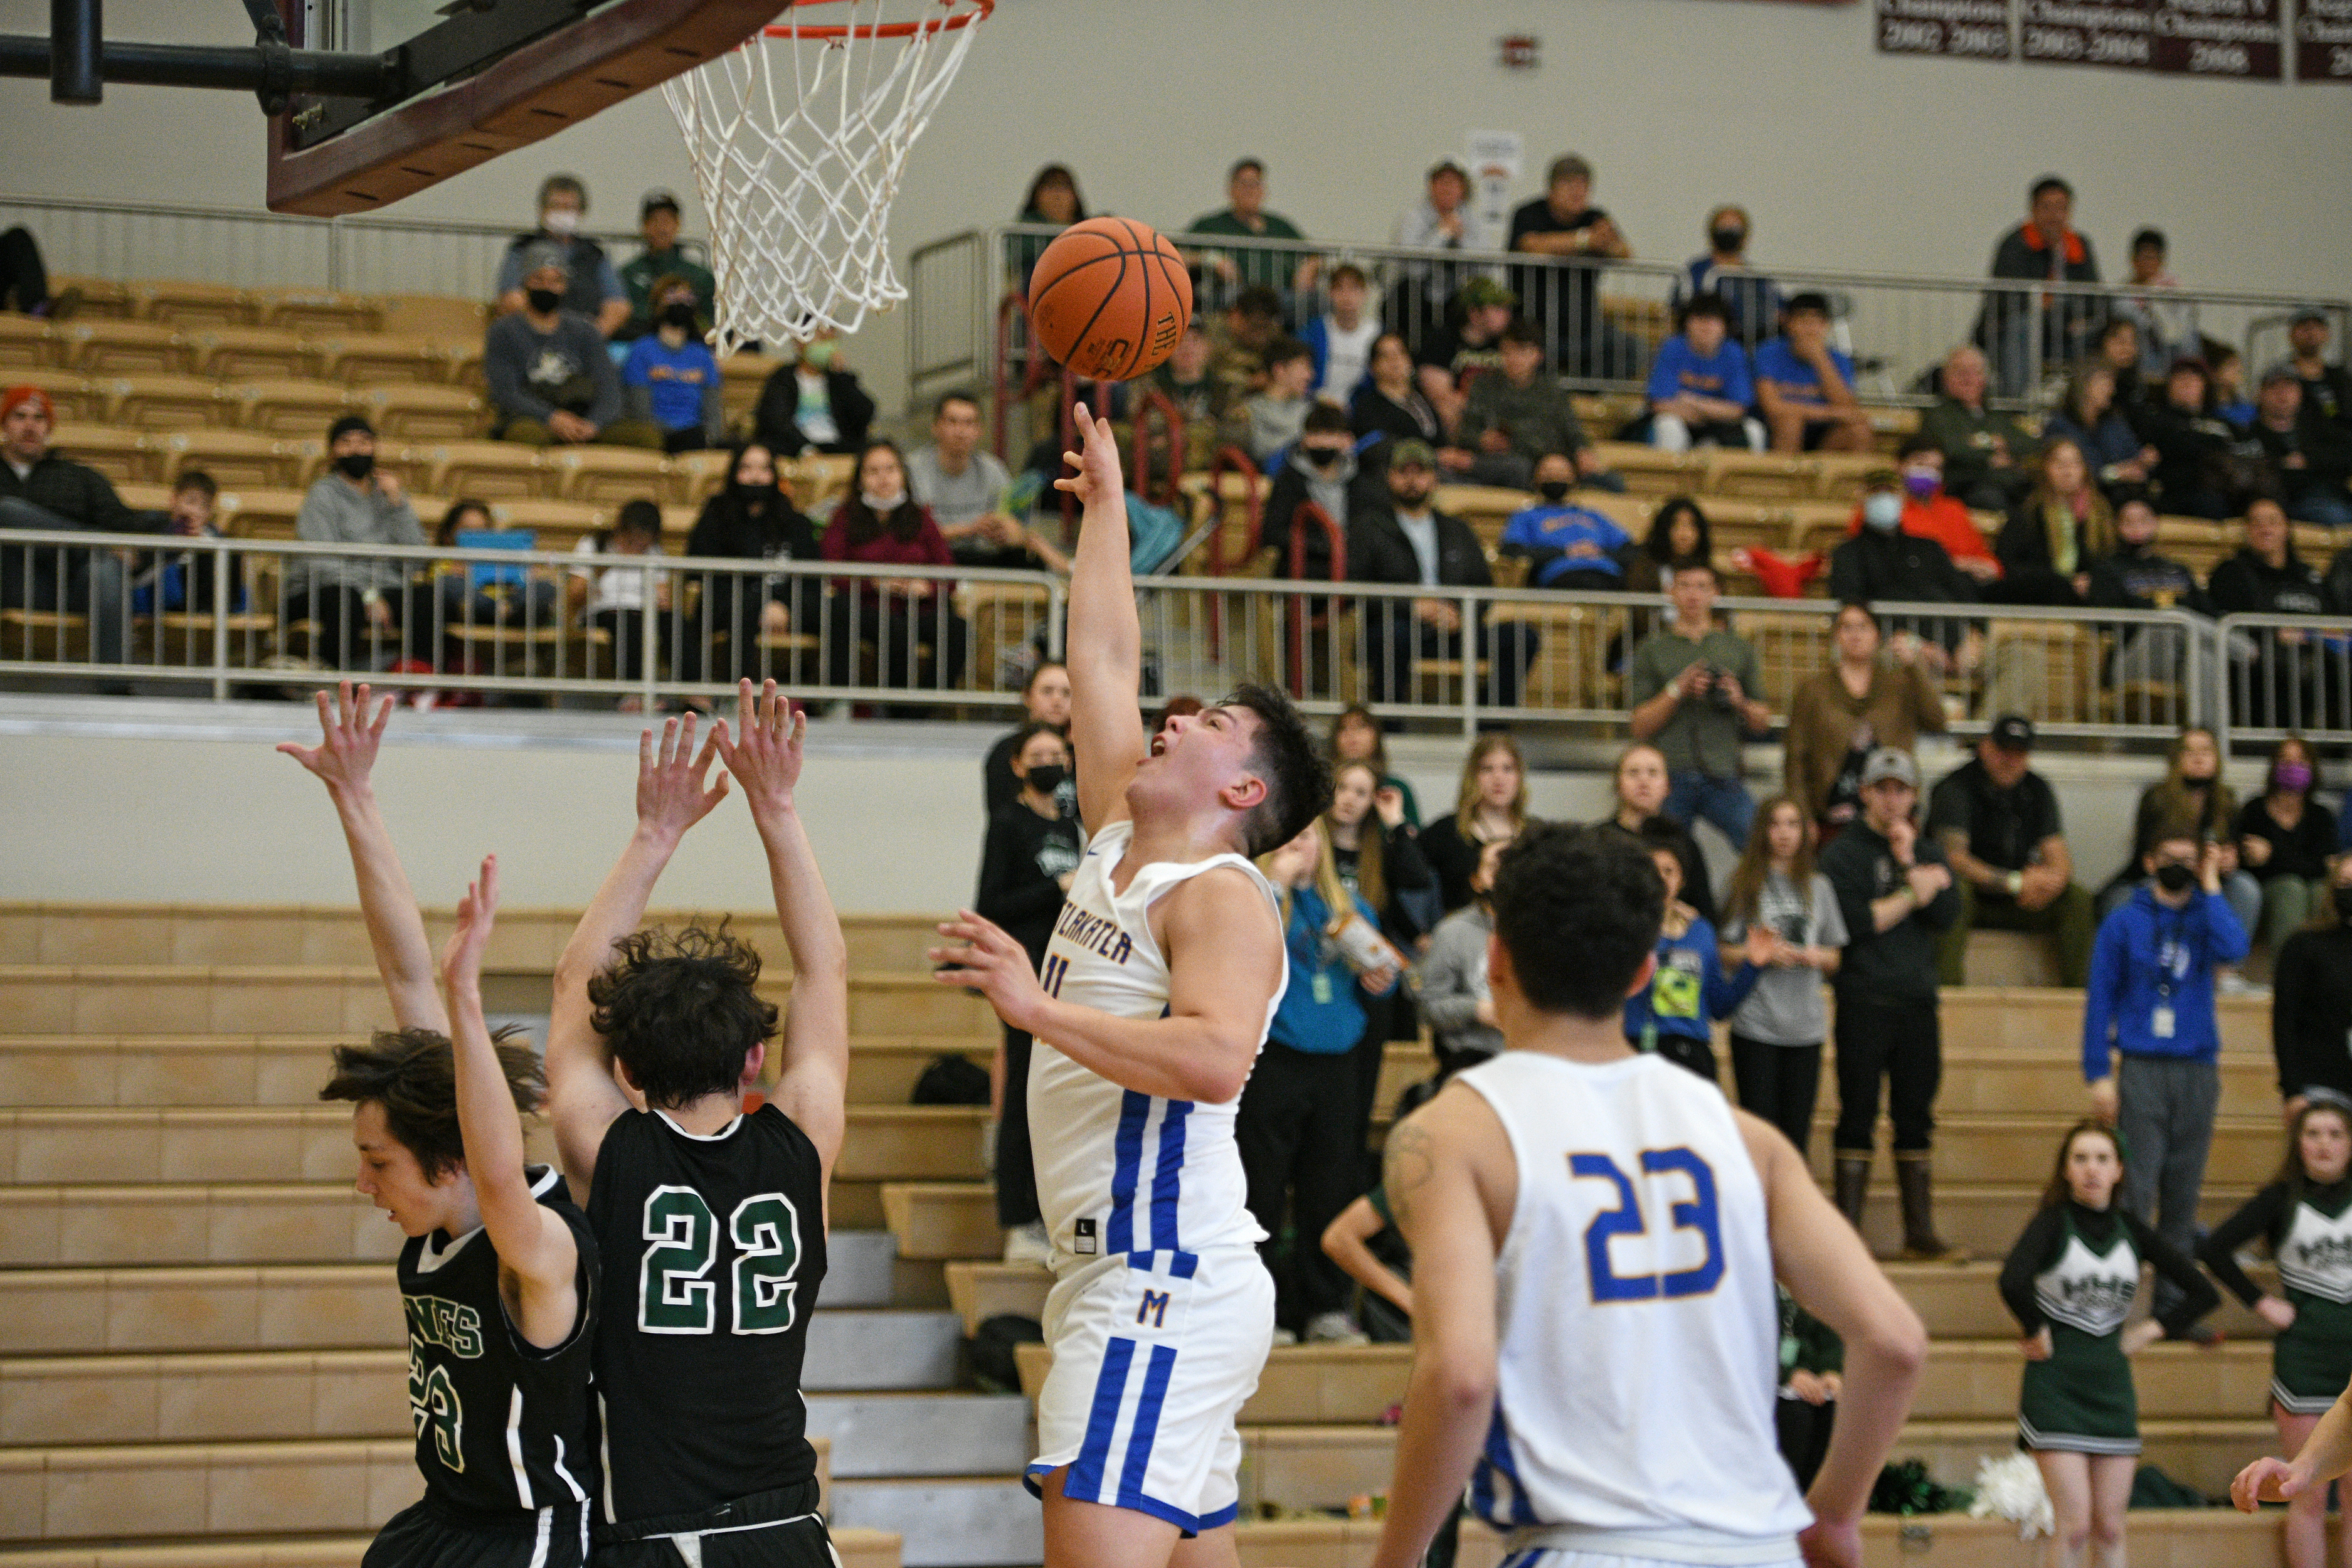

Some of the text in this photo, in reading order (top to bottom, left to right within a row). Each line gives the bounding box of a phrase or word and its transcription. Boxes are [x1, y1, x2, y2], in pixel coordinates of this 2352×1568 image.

[1042, 951, 1071, 1000] 11
[637, 1184, 802, 1335] 22
[1565, 1145, 1727, 1307] 23
[1136, 1288, 1172, 1329] M
